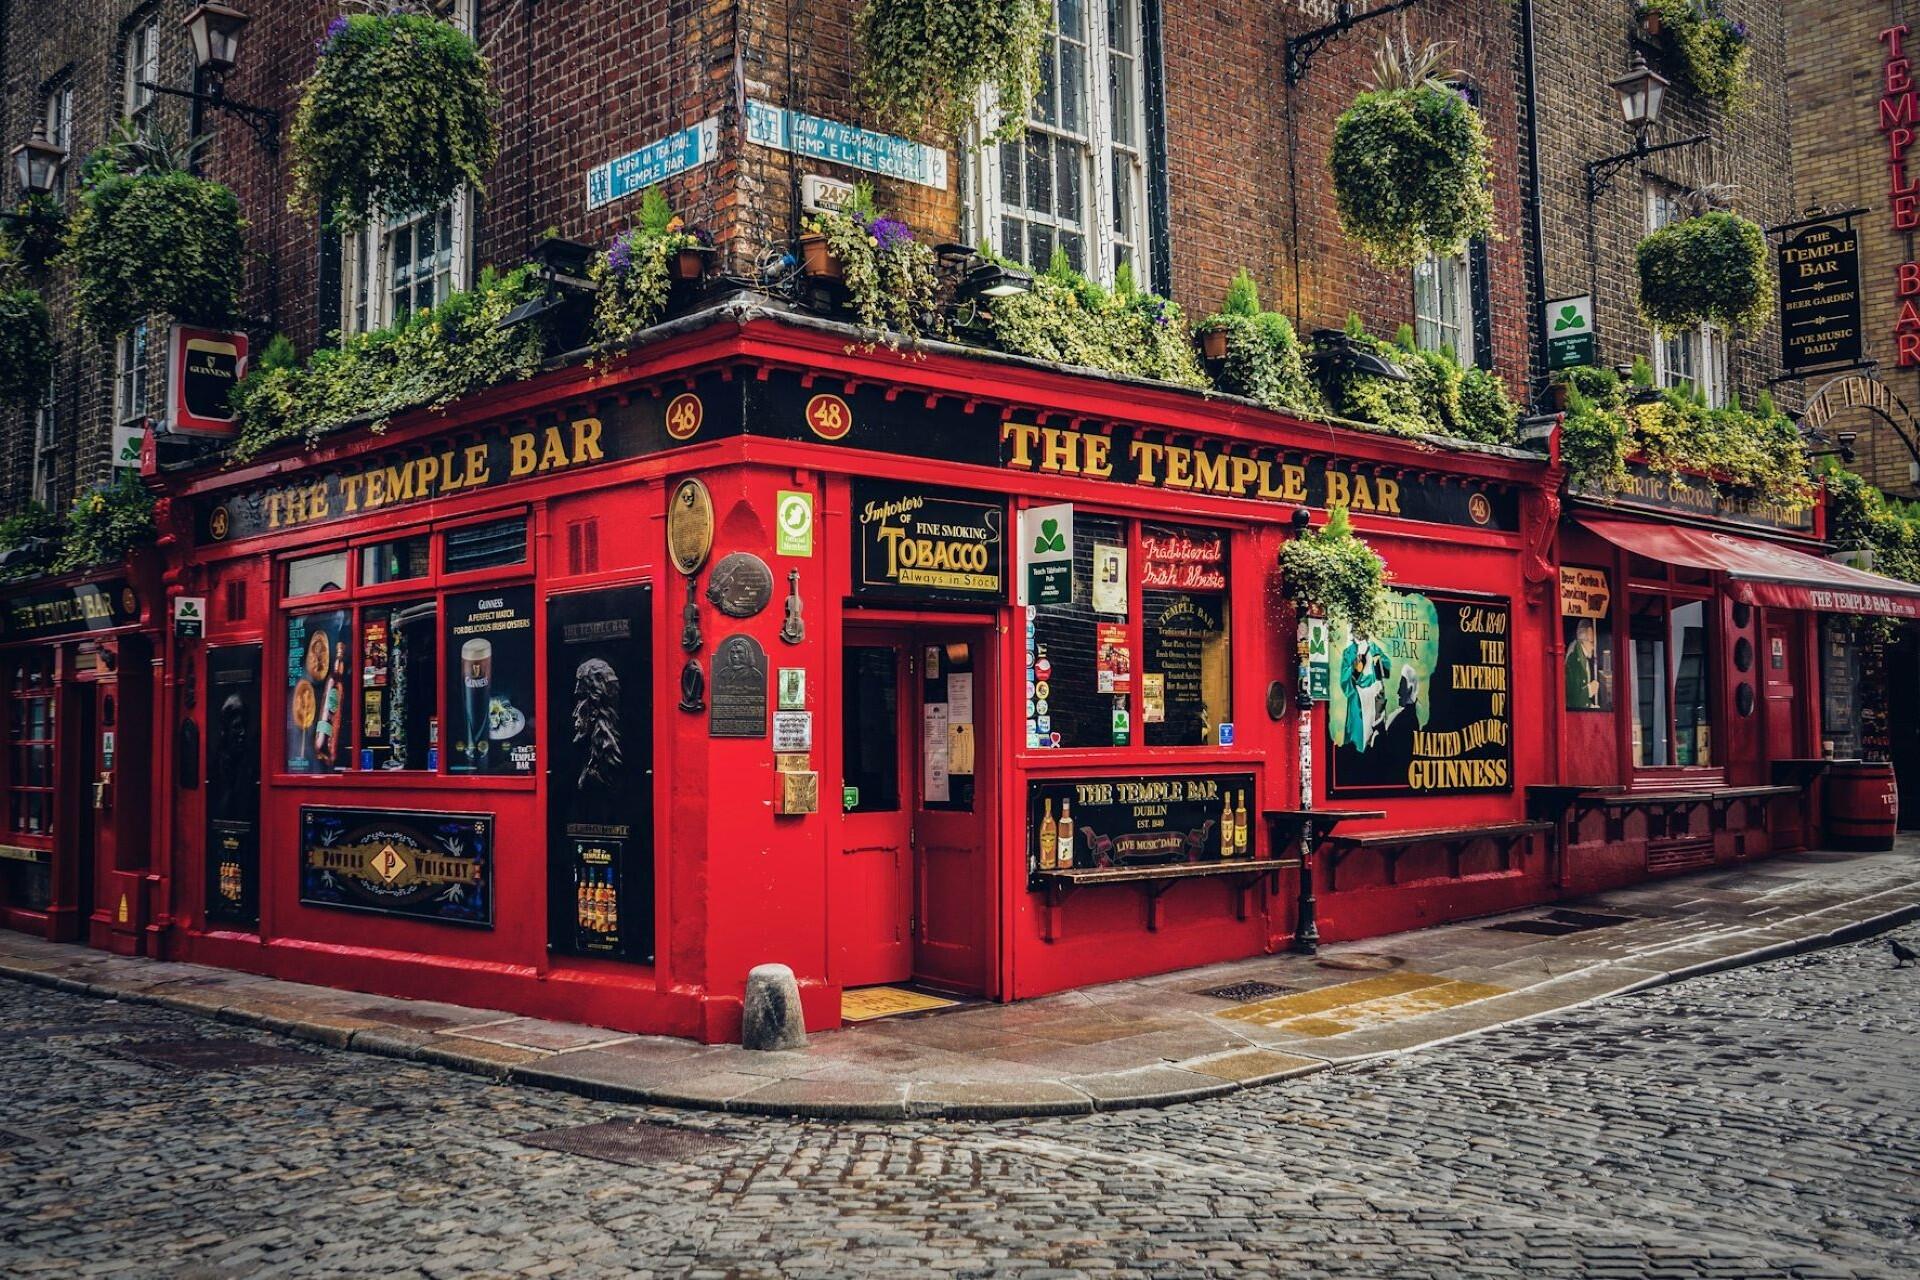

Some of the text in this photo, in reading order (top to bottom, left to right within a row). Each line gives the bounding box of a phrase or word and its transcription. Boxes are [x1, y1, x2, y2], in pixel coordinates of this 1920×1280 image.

[1878, 24, 1920, 230] TEMPLE
[790, 133, 839, 158] TEMPE
[624, 164, 660, 189] TEMPLE
[1805, 231, 1831, 244] THE
[1782, 239, 1855, 264] TEMPLE
[1800, 260, 1839, 278] BAR
[1786, 291, 1855, 311] BEER GARDEN
[1789, 328, 1853, 347] LIVE MUSIC
[1804, 342, 1838, 355] DAILY
[190, 365, 231, 378] GUINNESS
[671, 402, 696, 432] 48
[813, 400, 843, 429] 48
[1806, 391, 1837, 428] THE
[265, 417, 605, 528] THE TEMPLE BAR
[1003, 421, 1403, 515] THE TEMPLE BAR
[860, 496, 924, 527] Importers
[900, 513, 912, 524] OF
[1472, 499, 1486, 520] 48
[916, 522, 988, 540] FINE SMOKING
[877, 526, 989, 578] TOBACCO
[1141, 537, 1222, 560] Traditional
[901, 569, 997, 589] Always in Stock
[1141, 561, 1225, 589] Irish Music
[1561, 570, 1576, 584] Beer
[83, 592, 115, 619] BAR
[478, 598, 504, 610] GUINNESS
[1391, 601, 1418, 621] THE
[1810, 590, 1833, 607] THE
[1832, 592, 1873, 611] TEMPLE
[1872, 596, 1893, 613] BAR
[473, 611, 495, 621] PERFECT
[495, 608, 515, 618] MATCH
[1392, 640, 1420, 660] BAR
[1480, 639, 1505, 665] THE
[1452, 664, 1506, 691] EMPEROR
[1491, 692, 1506, 716] OF
[1412, 718, 1508, 758] MALTED LIQUORS
[510, 752, 537, 761] TEMPLE
[515, 761, 530, 770] BAR
[1408, 758, 1508, 790] GUINNESS
[1076, 780, 1219, 805] THE TEMPLE BAR
[1133, 804, 1168, 817] DUBLIN
[1136, 819, 1151, 829] EST.
[1116, 838, 1183, 853] LIVE MUSIC DAILY
[323, 850, 364, 869] POWERS
[414, 856, 469, 878] WHISKEY
